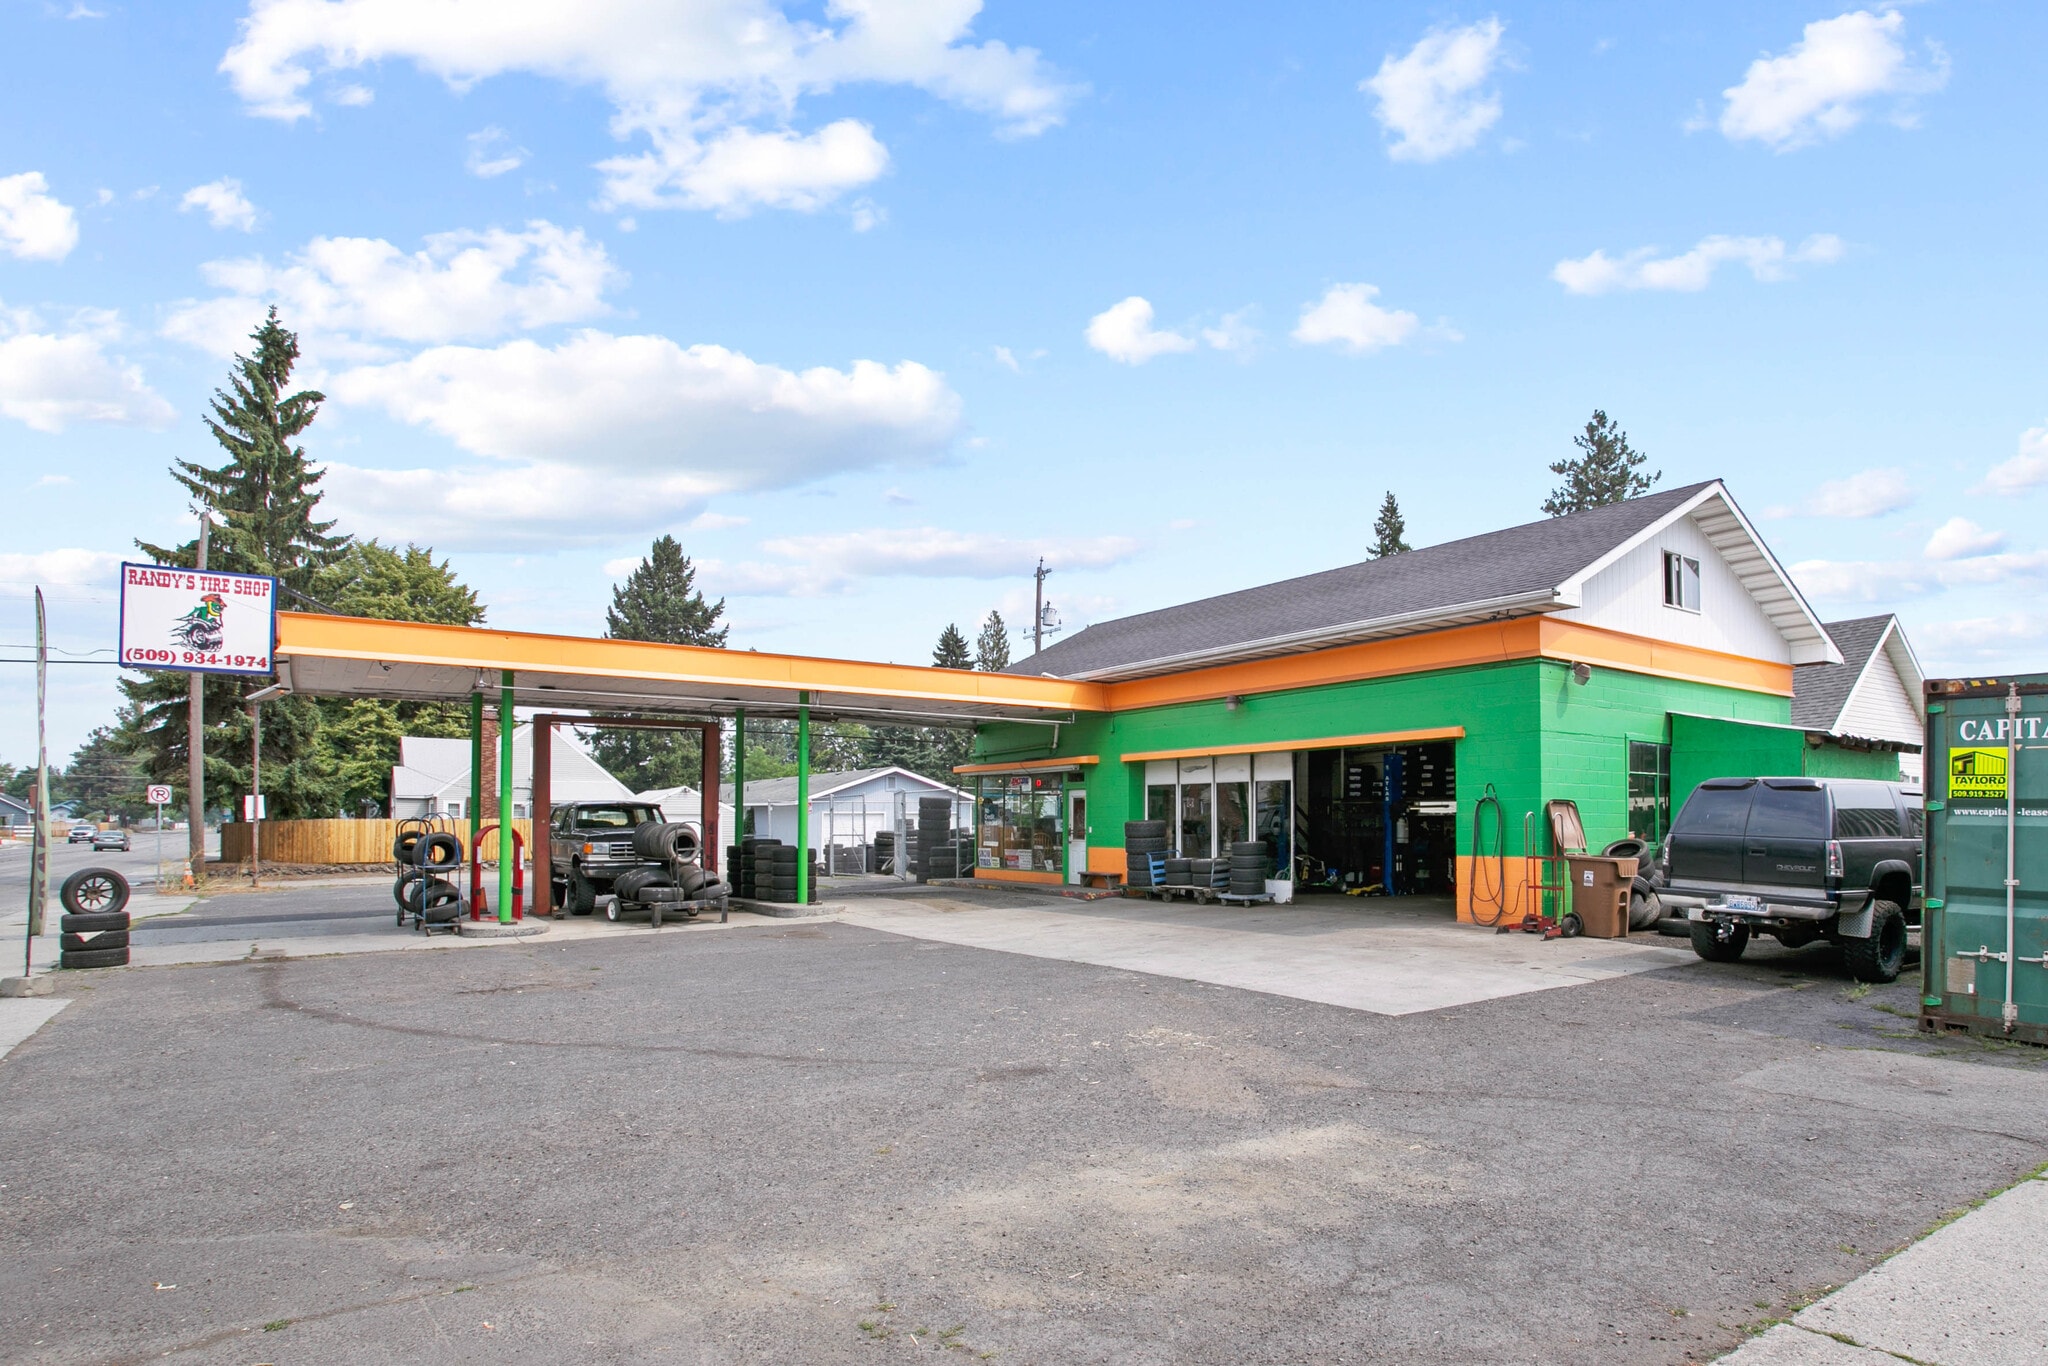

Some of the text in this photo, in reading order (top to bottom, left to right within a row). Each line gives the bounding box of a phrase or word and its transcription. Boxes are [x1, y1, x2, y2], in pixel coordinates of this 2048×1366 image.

[128, 569, 270, 597] RANDY'S TIRE SHOP
[125, 647, 267, 668] (509) 934-1974
